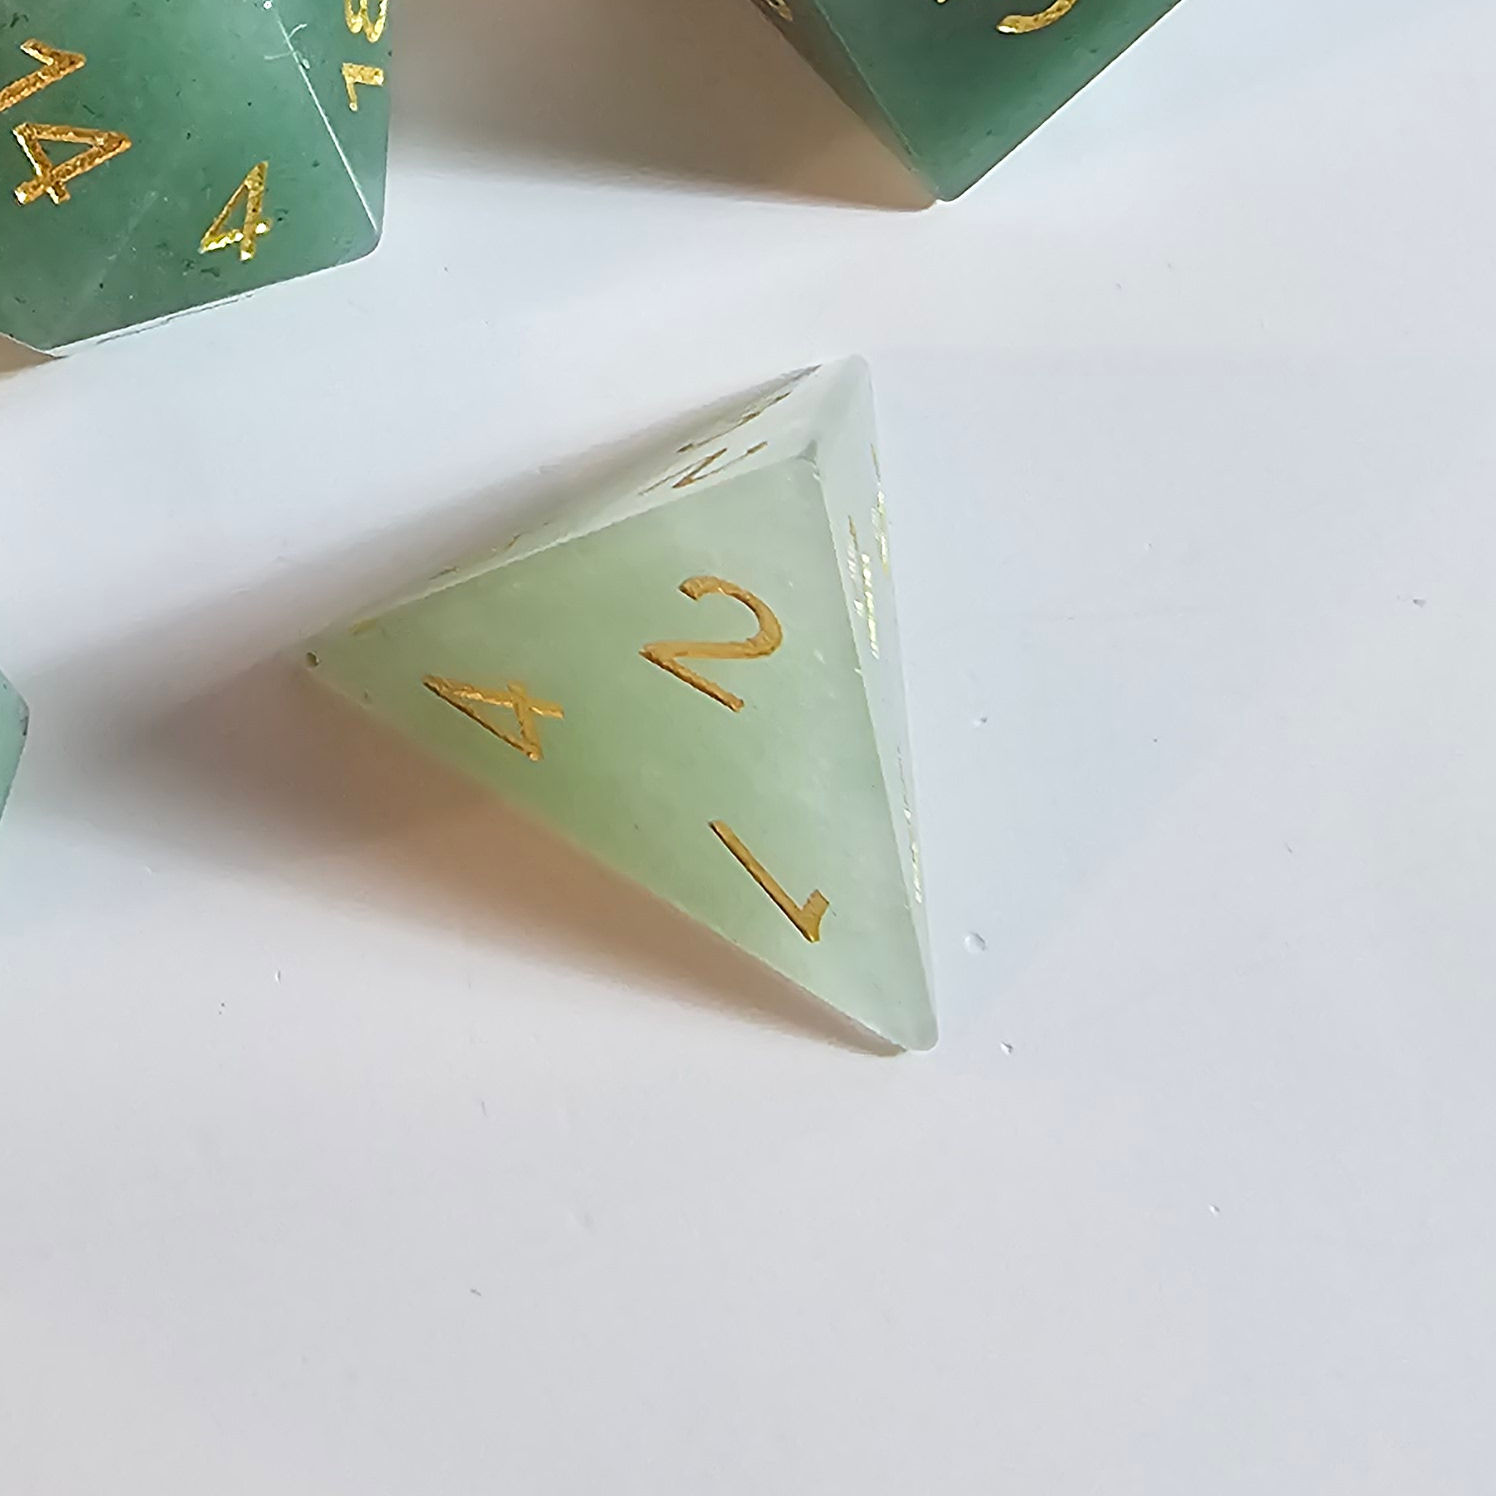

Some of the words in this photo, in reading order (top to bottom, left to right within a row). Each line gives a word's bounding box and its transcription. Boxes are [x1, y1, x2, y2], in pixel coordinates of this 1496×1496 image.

[202, 163, 271, 259] 4
[639, 576, 783, 712] 2
[423, 675, 564, 761] 4
